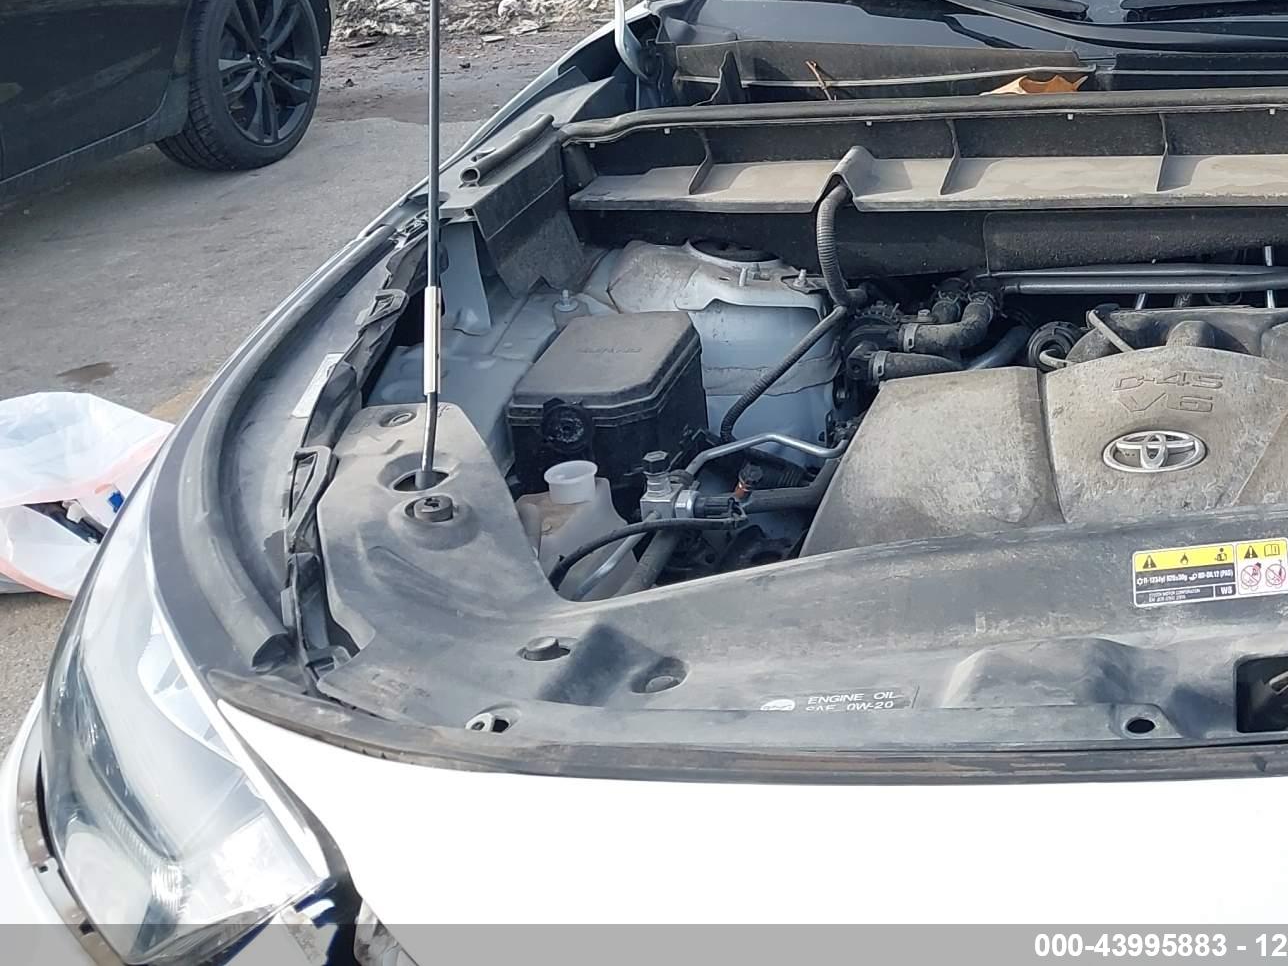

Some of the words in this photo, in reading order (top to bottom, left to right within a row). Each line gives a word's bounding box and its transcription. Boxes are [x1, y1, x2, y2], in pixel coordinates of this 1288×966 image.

[807, 693, 865, 704] ENGINE
[873, 691, 896, 700] OIL
[846, 700, 894, 711] 0W-20
